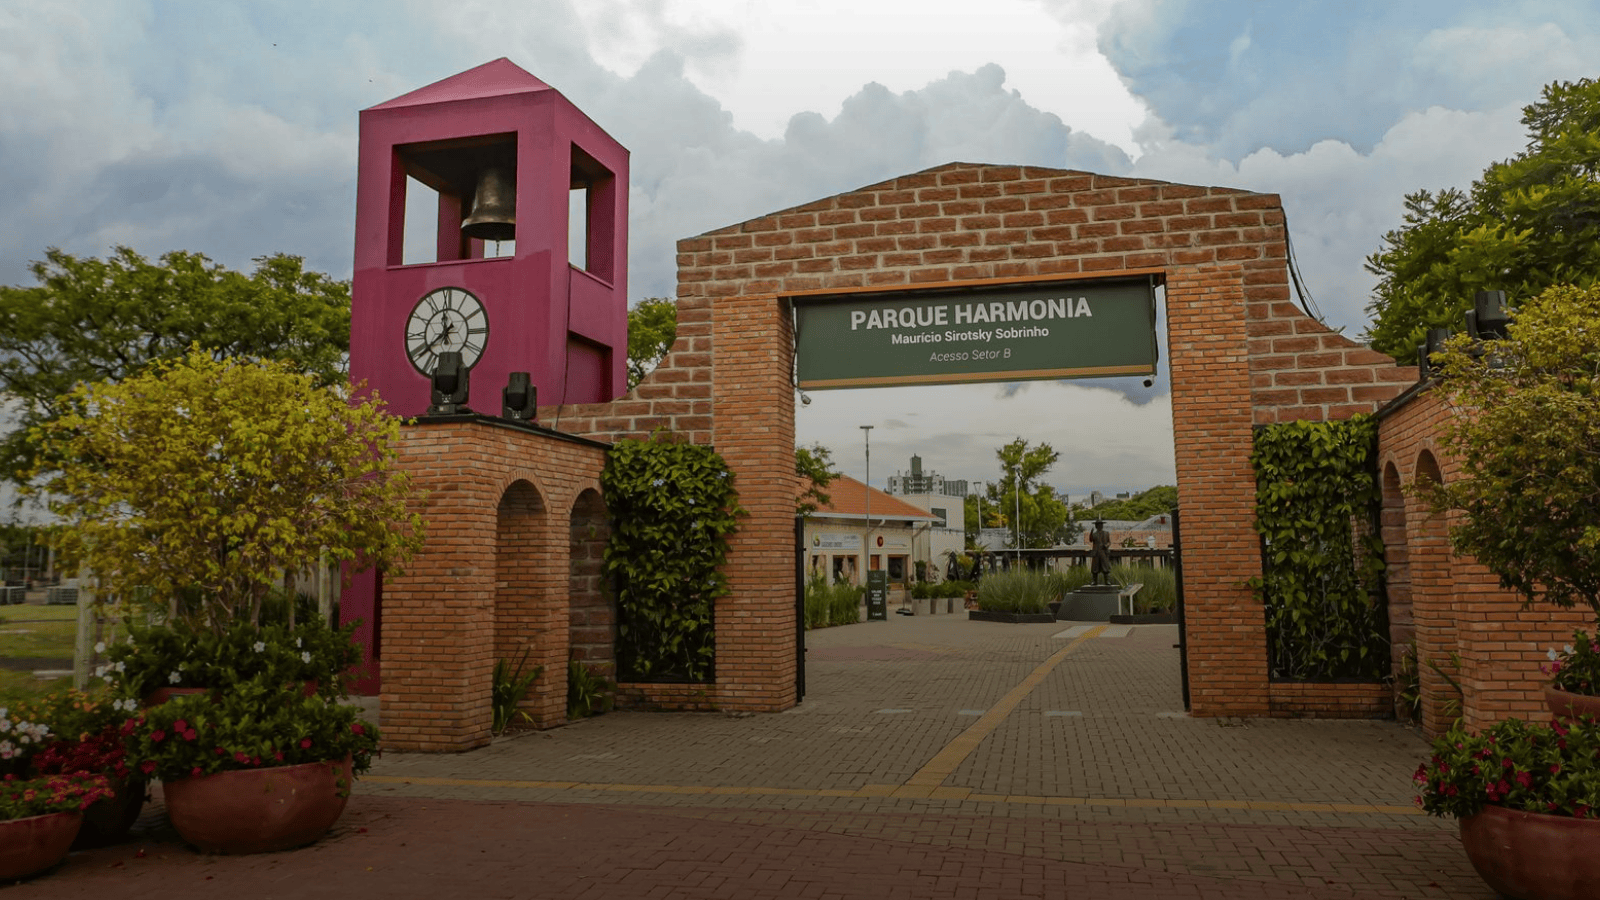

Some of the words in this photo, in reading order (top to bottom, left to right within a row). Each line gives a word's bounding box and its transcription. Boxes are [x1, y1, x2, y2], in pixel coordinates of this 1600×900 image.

[851, 305, 949, 330] PARQUE
[955, 297, 1093, 324] HARMONIA
[891, 330, 942, 345] Maurício
[944, 328, 993, 343] Sirotsky
[995, 325, 1050, 339] Sobrinho
[929, 351, 969, 362] Acesso
[972, 349, 1001, 360] Setor
[1003, 347, 1011, 358] B
